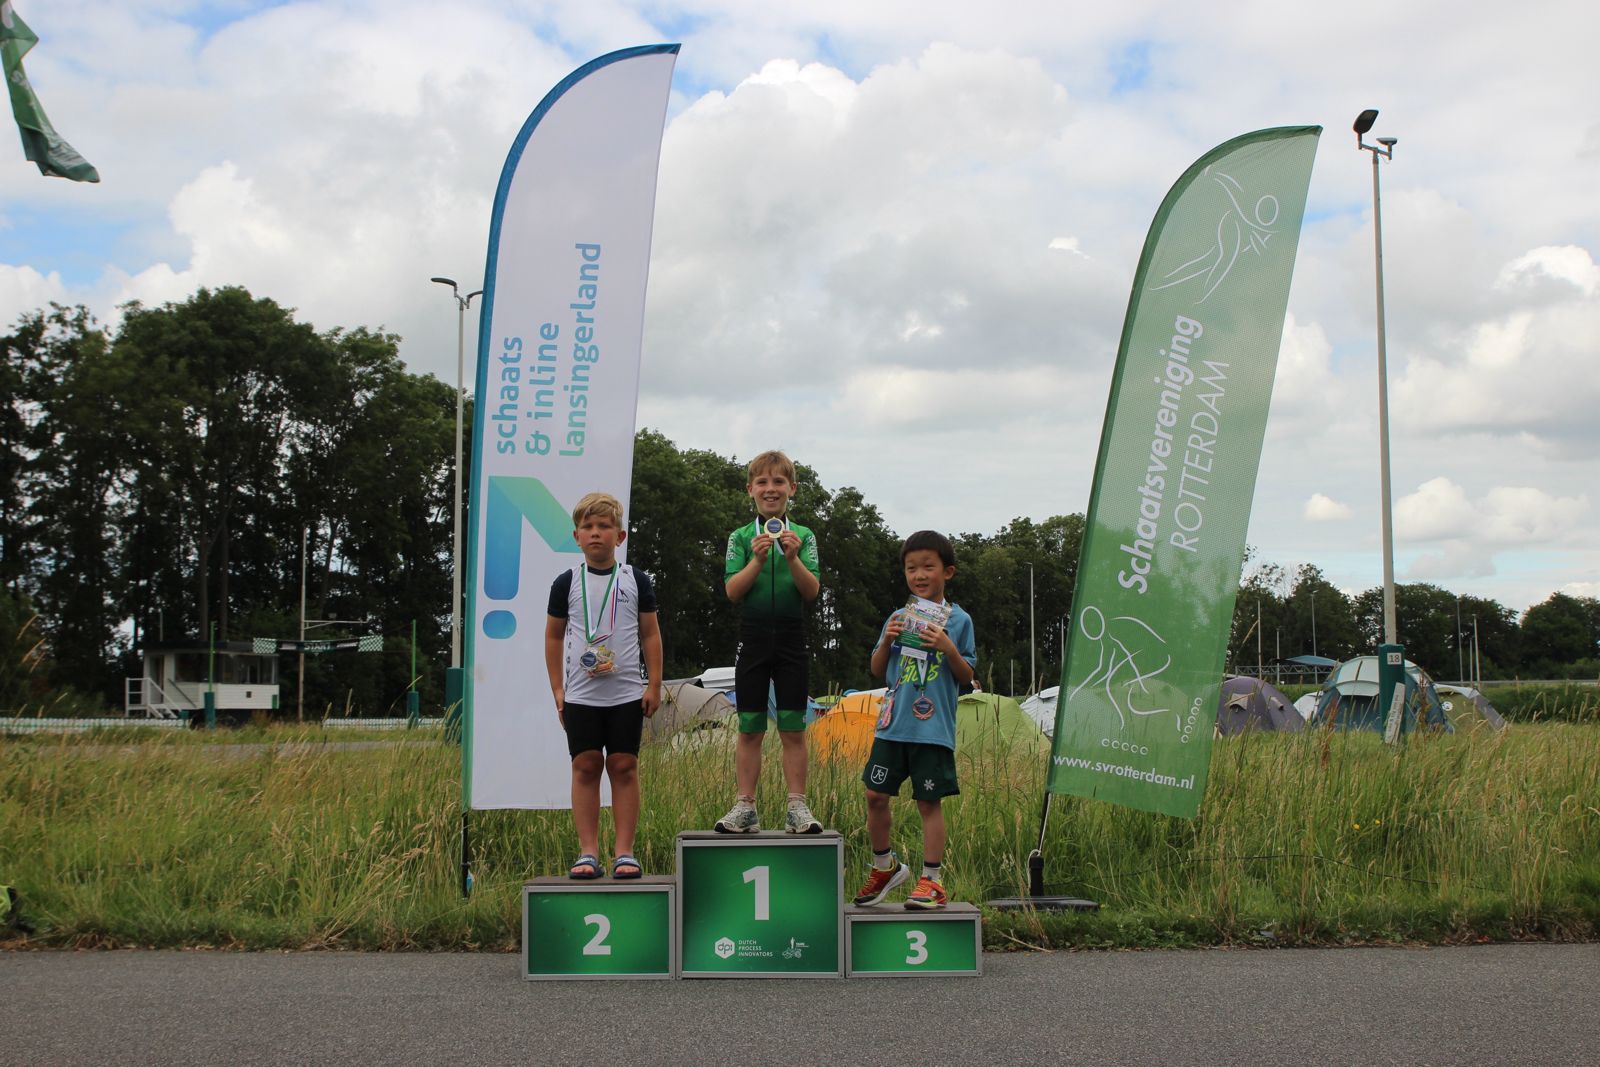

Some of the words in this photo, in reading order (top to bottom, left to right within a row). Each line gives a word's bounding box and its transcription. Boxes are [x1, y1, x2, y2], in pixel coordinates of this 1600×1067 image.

[526, 322, 559, 424] inline
[559, 243, 601, 457] lansingerland
[491, 336, 523, 455] schaats
[525, 429, 551, 456] &
[1117, 314, 1204, 594] Schaatsvereniging
[1169, 359, 1230, 553] ROTTERDAM
[1388, 654, 1400, 663] 18
[1053, 754, 1195, 790] www.svrotterdam.nl
[742, 866, 770, 921] 1
[582, 914, 611, 956] 2
[905, 930, 928, 965] 3
